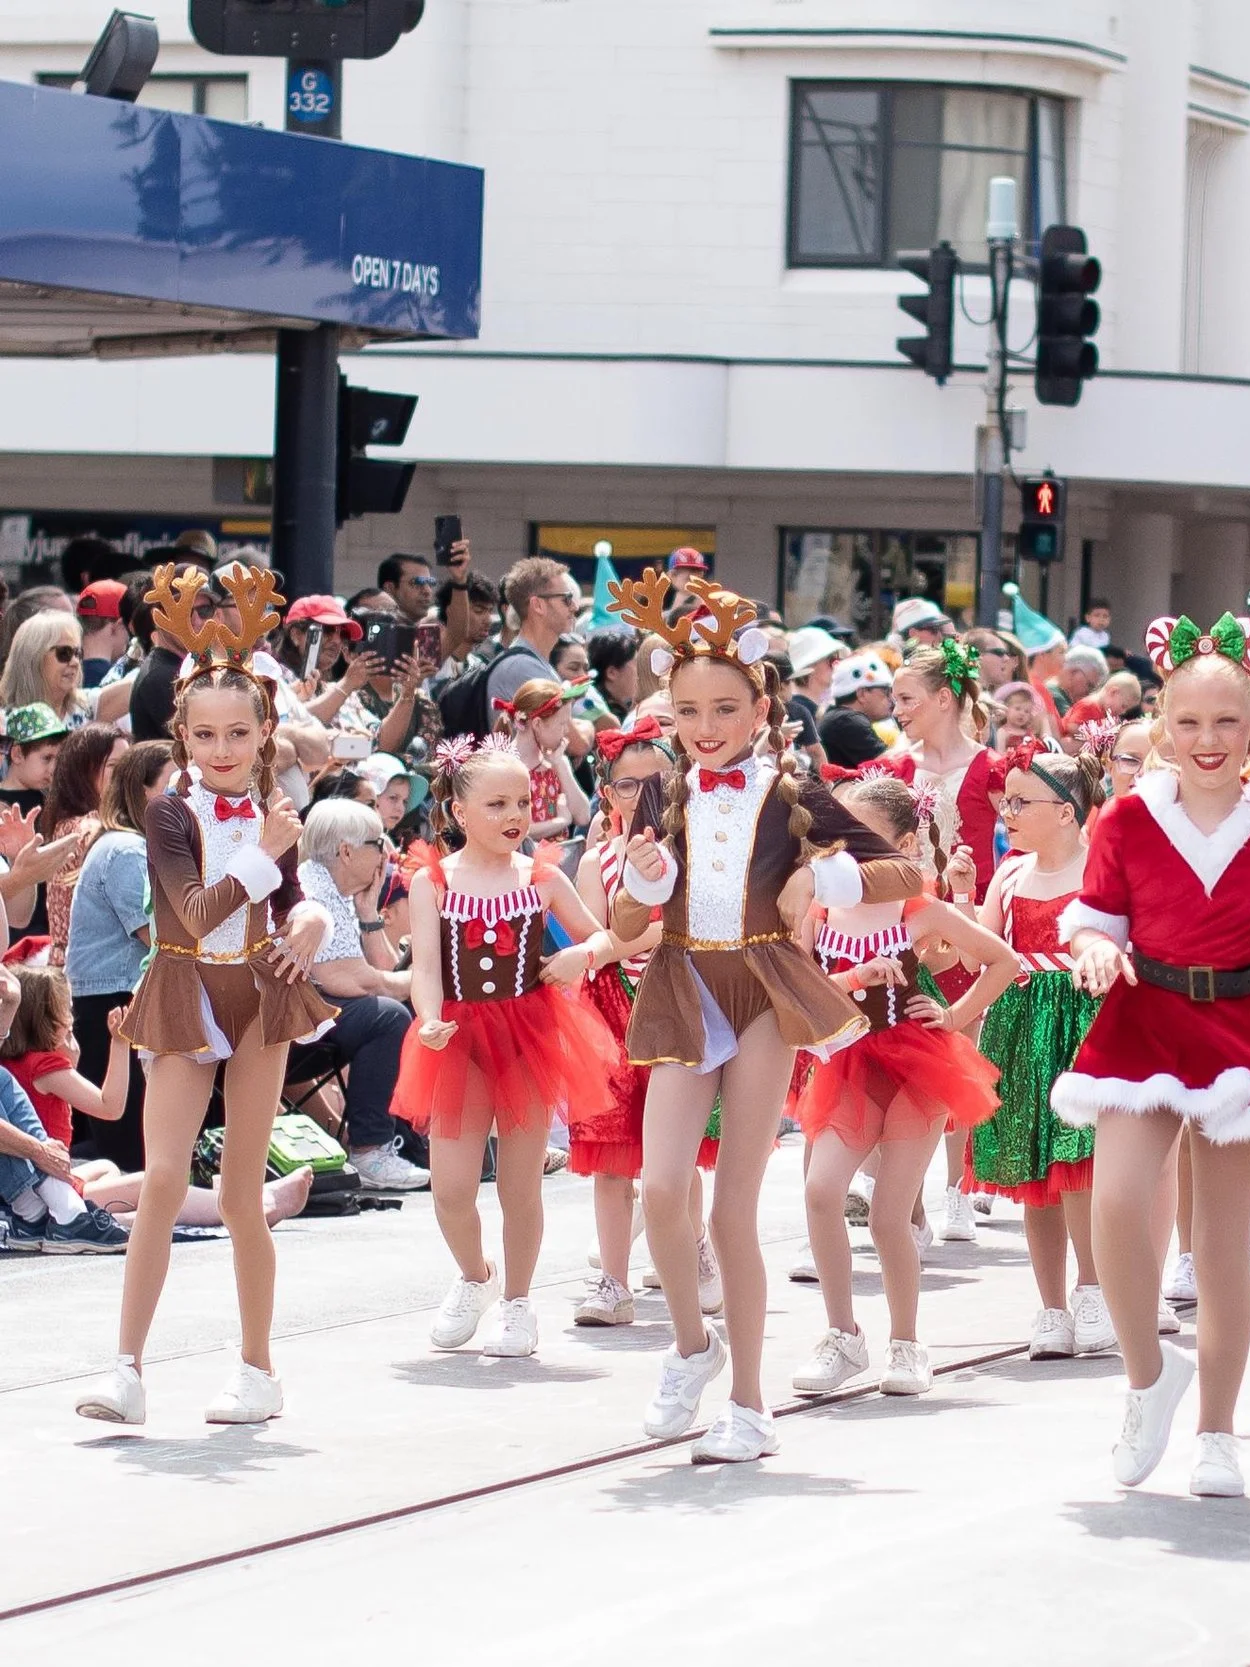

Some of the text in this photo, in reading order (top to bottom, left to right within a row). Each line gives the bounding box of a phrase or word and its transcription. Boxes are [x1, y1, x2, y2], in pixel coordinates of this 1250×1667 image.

[301, 71, 317, 91] G
[290, 91, 329, 113] 332
[352, 254, 438, 296] OPEN 7 DAYS
